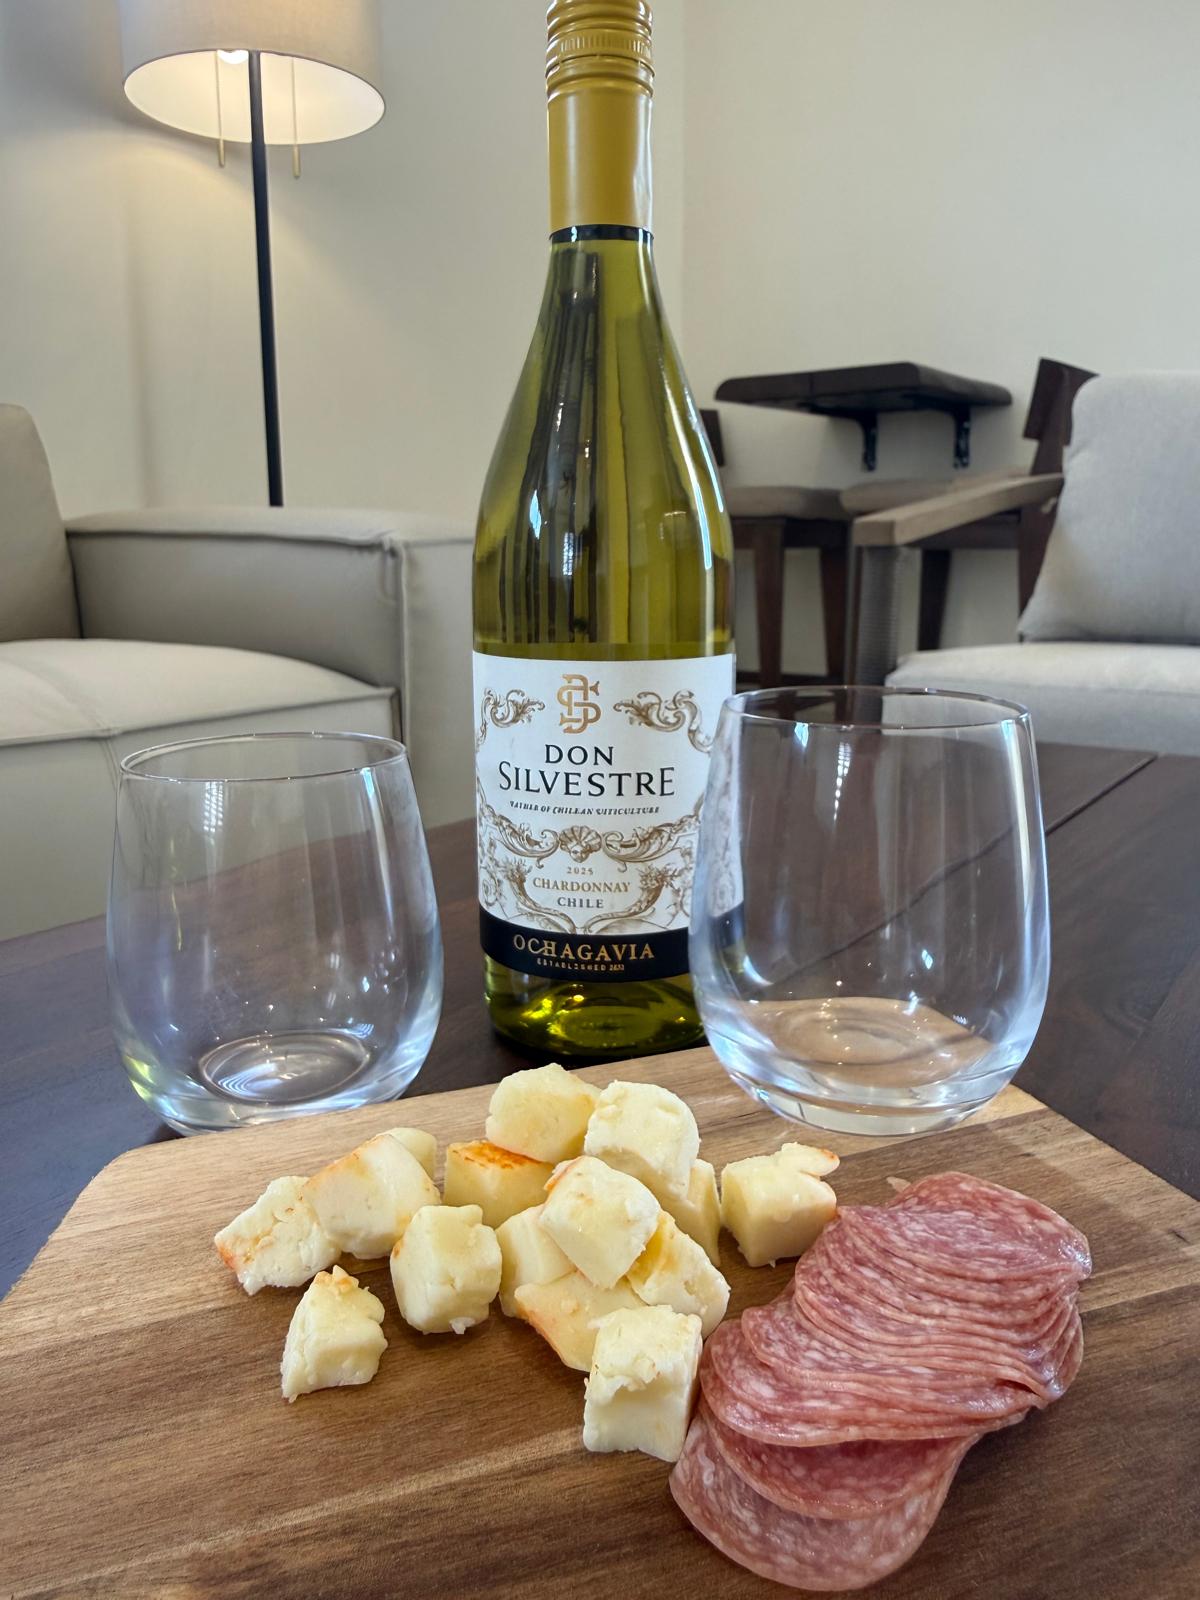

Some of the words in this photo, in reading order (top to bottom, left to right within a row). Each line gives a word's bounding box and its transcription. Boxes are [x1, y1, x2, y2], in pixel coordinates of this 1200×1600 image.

[544, 743, 614, 766] DON
[498, 760, 675, 797] SILVESTRE
[552, 806, 593, 815] CHILEAN
[532, 877, 631, 894] CHARDONNAY
[557, 896, 604, 909] CHILE
[513, 933, 655, 962] OCHAGAVIA
